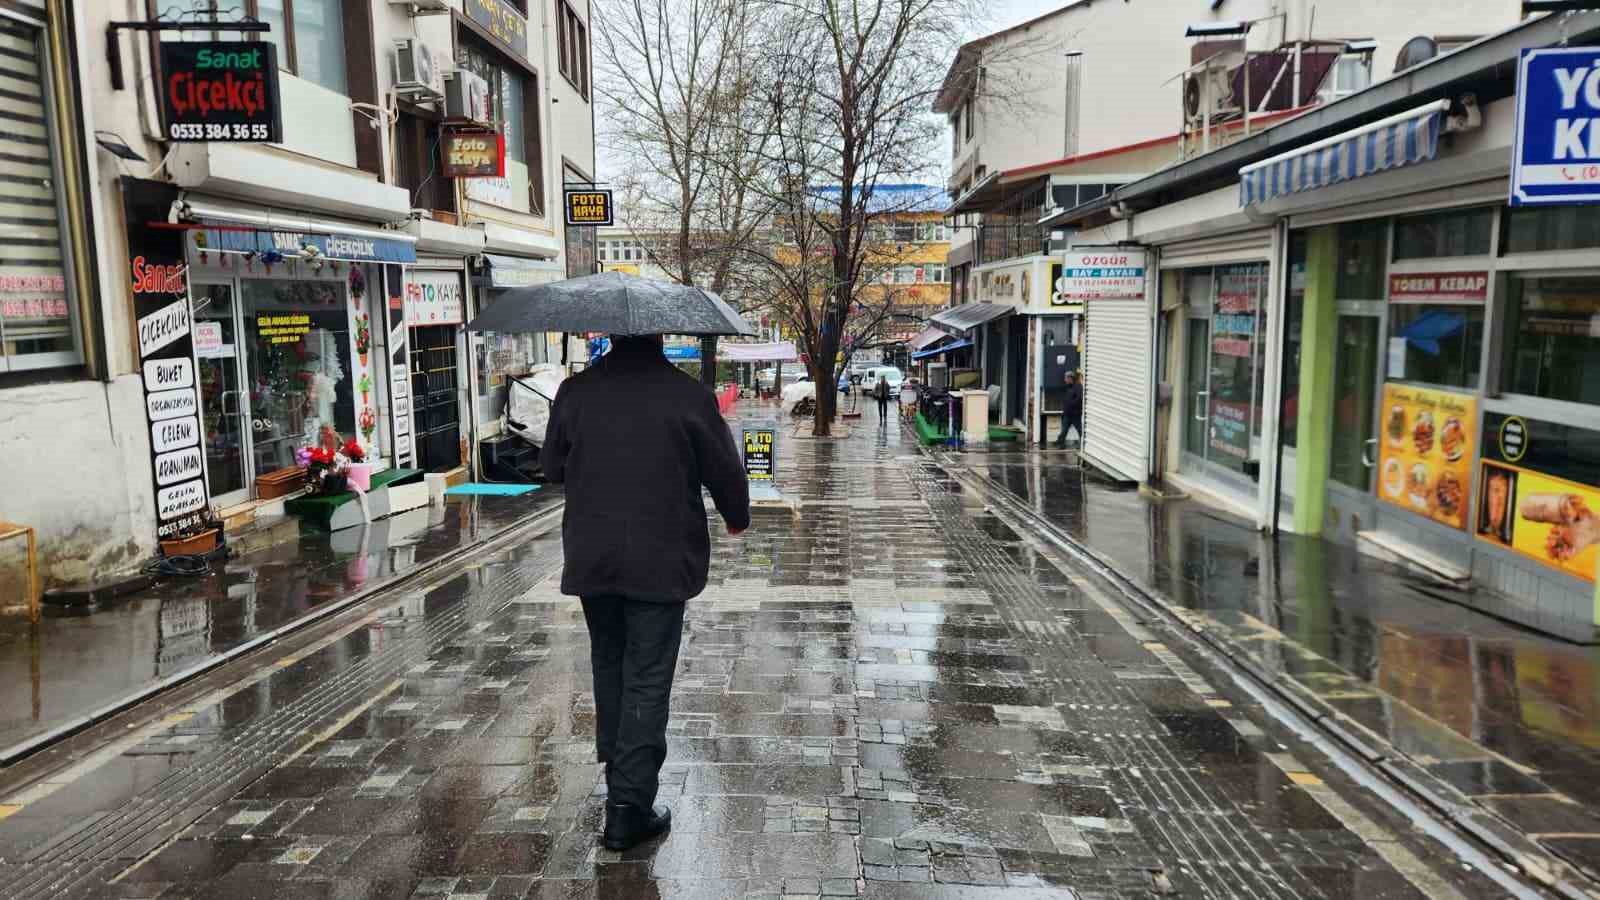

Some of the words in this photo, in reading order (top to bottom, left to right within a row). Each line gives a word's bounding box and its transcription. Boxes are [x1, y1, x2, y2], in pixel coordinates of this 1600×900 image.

[196, 50, 262, 68] Sanat
[169, 71, 265, 117] Çiçekçi
[171, 124, 203, 139] 0533
[206, 124, 231, 139] 384
[233, 124, 249, 139] 36
[251, 124, 268, 139] 55
[453, 138, 486, 150] Foto
[450, 152, 491, 168] Kaya
[572, 194, 604, 205] FOTO
[573, 205, 604, 217] KAYA
[132, 255, 187, 293] Sanat
[1440, 276, 1486, 291] KEBAP
[437, 283, 461, 301] KAYA
[156, 364, 183, 383] BUKET
